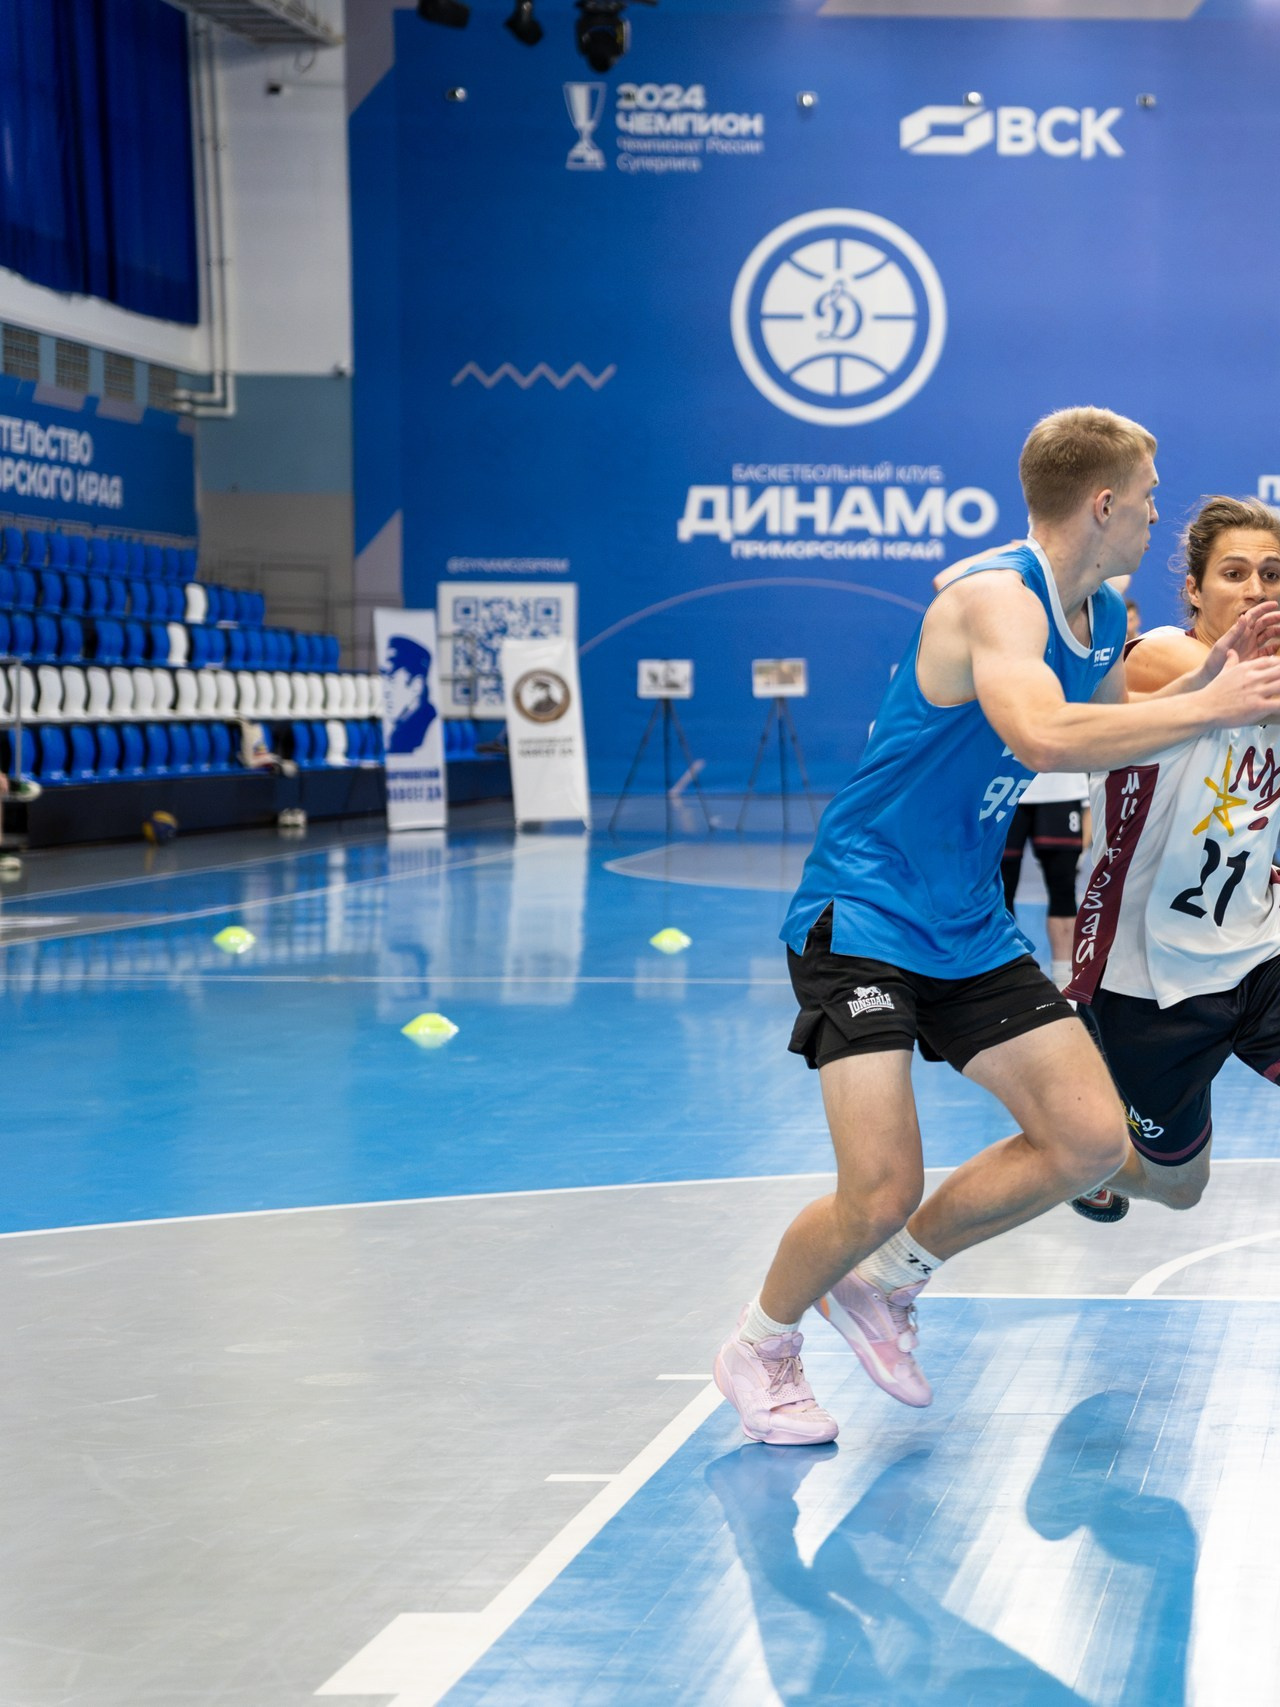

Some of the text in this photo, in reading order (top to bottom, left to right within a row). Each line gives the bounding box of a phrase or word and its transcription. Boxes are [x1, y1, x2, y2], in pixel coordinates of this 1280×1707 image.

[616, 83, 706, 111] 2024
[615, 112, 764, 137] ЧЕМПИОН
[997, 106, 1125, 159] ВСК
[705, 137, 764, 154] России
[616, 152, 702, 174] Суперлига
[0, 456, 124, 509] РСКОГО КРАЯ
[732, 461, 945, 484] БАСКЕТБОЛЬНЫЙ КЛУБ
[677, 484, 999, 543] ДИНАМО
[731, 538, 945, 560] ПРИМОРСКИЙ КРАЙ
[1069, 811, 1080, 833] 8
[1170, 838, 1250, 928] 21
[847, 993, 896, 1018] LONSDALE
